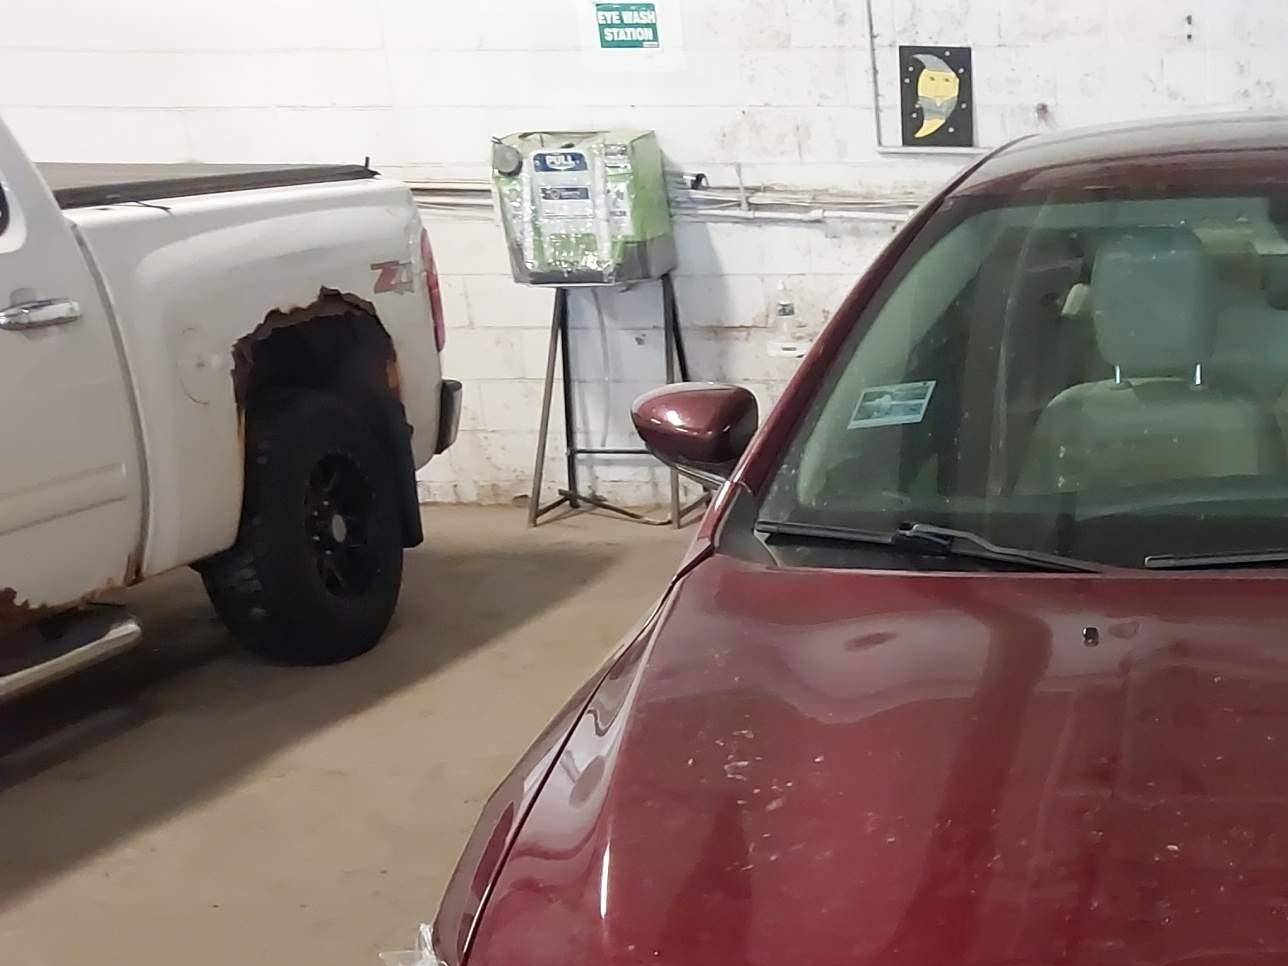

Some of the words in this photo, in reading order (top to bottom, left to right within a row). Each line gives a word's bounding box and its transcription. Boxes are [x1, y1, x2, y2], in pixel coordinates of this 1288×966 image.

[597, 11, 621, 24] EYE
[622, 10, 657, 24] WASH
[604, 27, 654, 41] STATION
[545, 155, 577, 167] PULL
